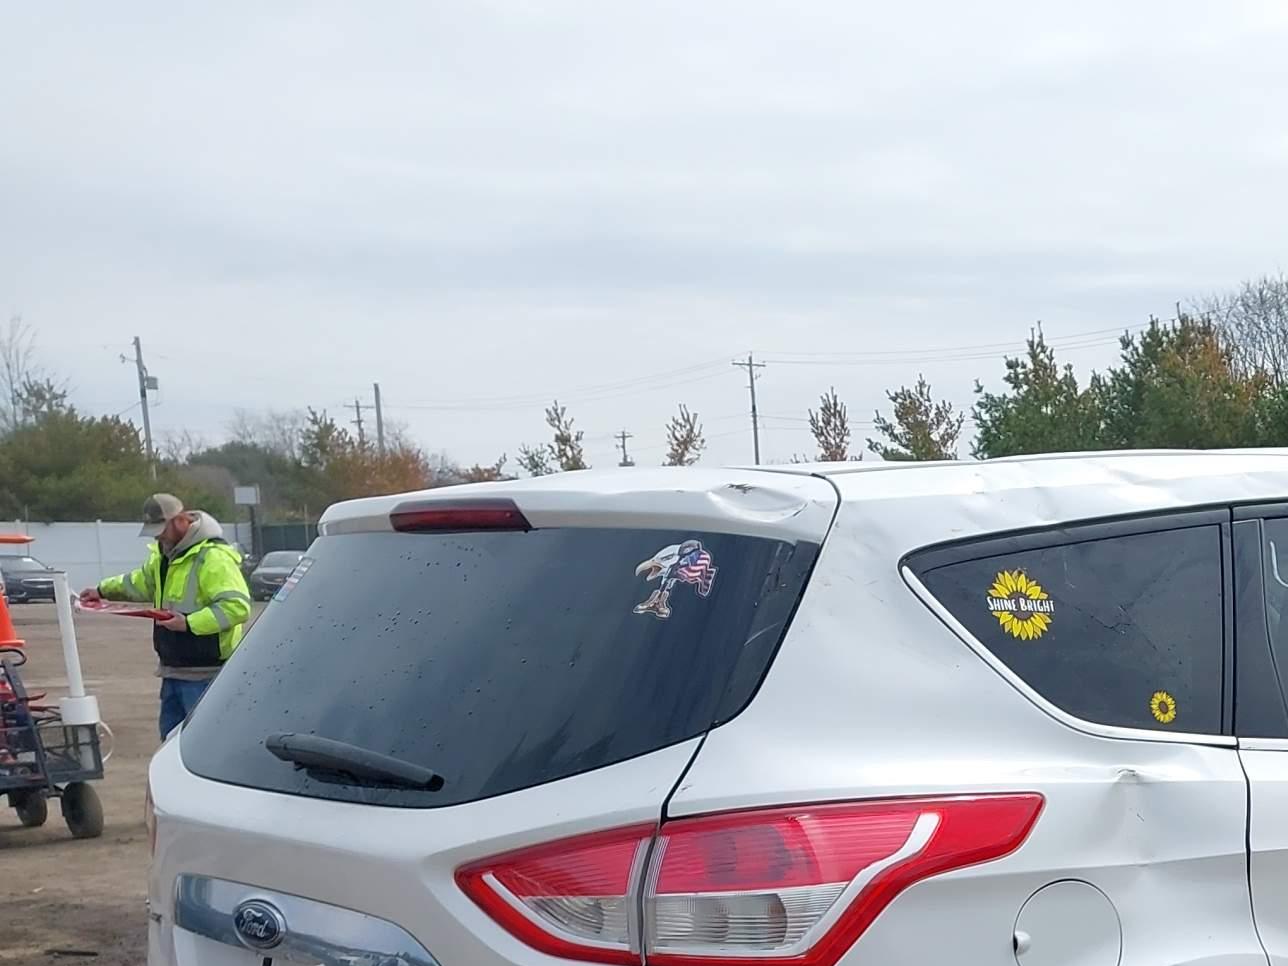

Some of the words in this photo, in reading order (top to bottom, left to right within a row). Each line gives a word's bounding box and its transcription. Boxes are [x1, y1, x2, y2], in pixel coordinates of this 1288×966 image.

[987, 596, 1018, 611] SHINE
[1019, 597, 1055, 612] BRIGHT
[240, 908, 269, 938] Ford
